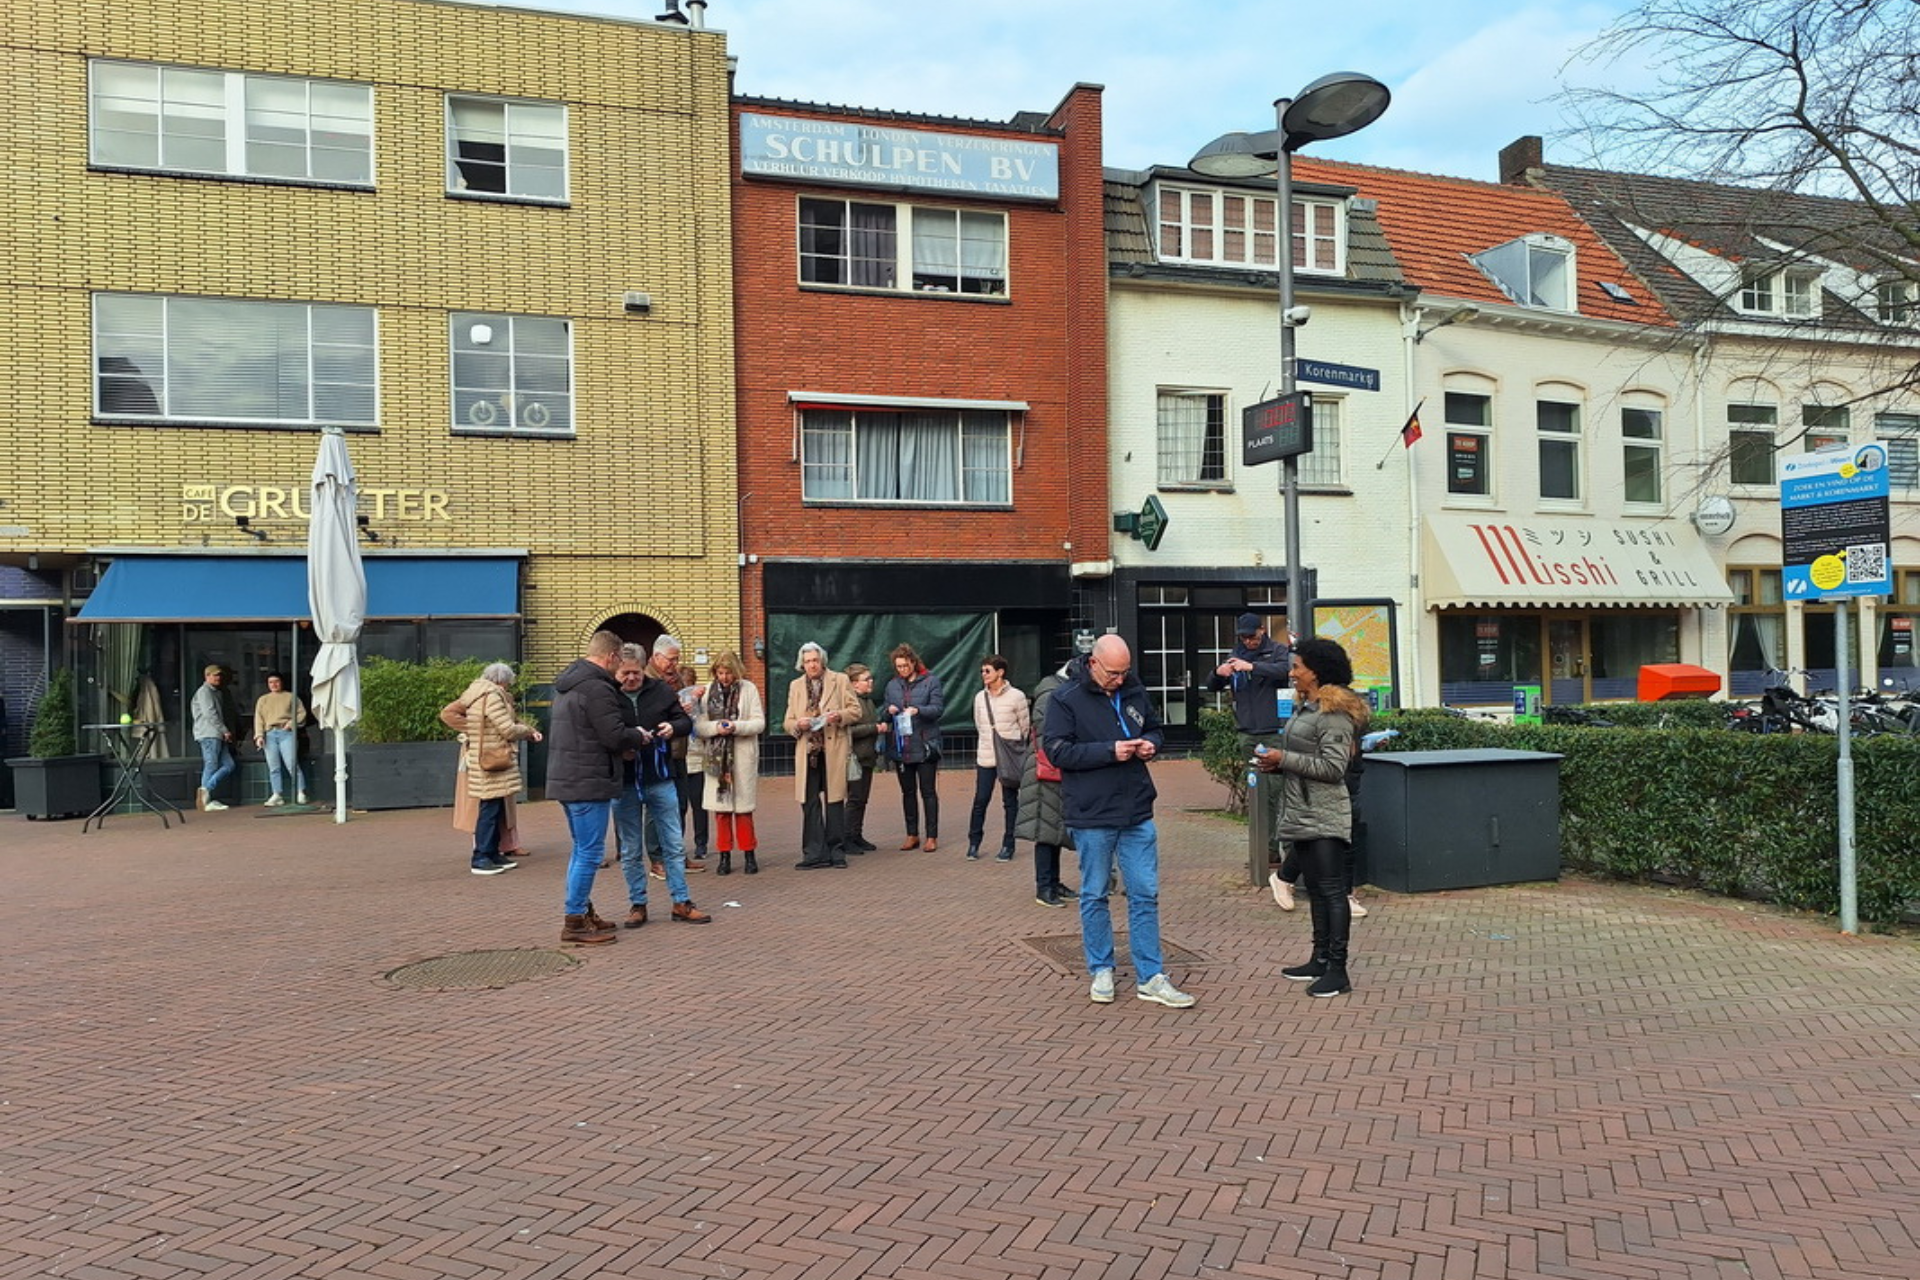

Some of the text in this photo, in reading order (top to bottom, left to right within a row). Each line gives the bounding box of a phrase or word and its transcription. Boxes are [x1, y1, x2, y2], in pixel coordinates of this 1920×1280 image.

[750, 117, 1051, 156] AMSTERDAM LONDEN VERZEKERINGEN
[765, 133, 1036, 181] SCHULPEN BV
[753, 160, 1048, 197] VERHUUR VERKOOP HYPOTHEKEN TAXATIES
[1248, 434, 1274, 449] PLAATS
[1790, 491, 1815, 500] MARKT
[1824, 484, 1879, 496] KORENMARKT
[1794, 482, 1813, 492] ZOEK
[1815, 481, 1825, 489] EN
[1827, 478, 1847, 487] VIND
[1849, 476, 1861, 484] OP
[183, 504, 212, 520] DE
[1612, 528, 1676, 547] SUSHI
[1467, 524, 1618, 585] Misshi
[1649, 550, 1662, 565] &
[1635, 569, 1698, 587] GRILL
